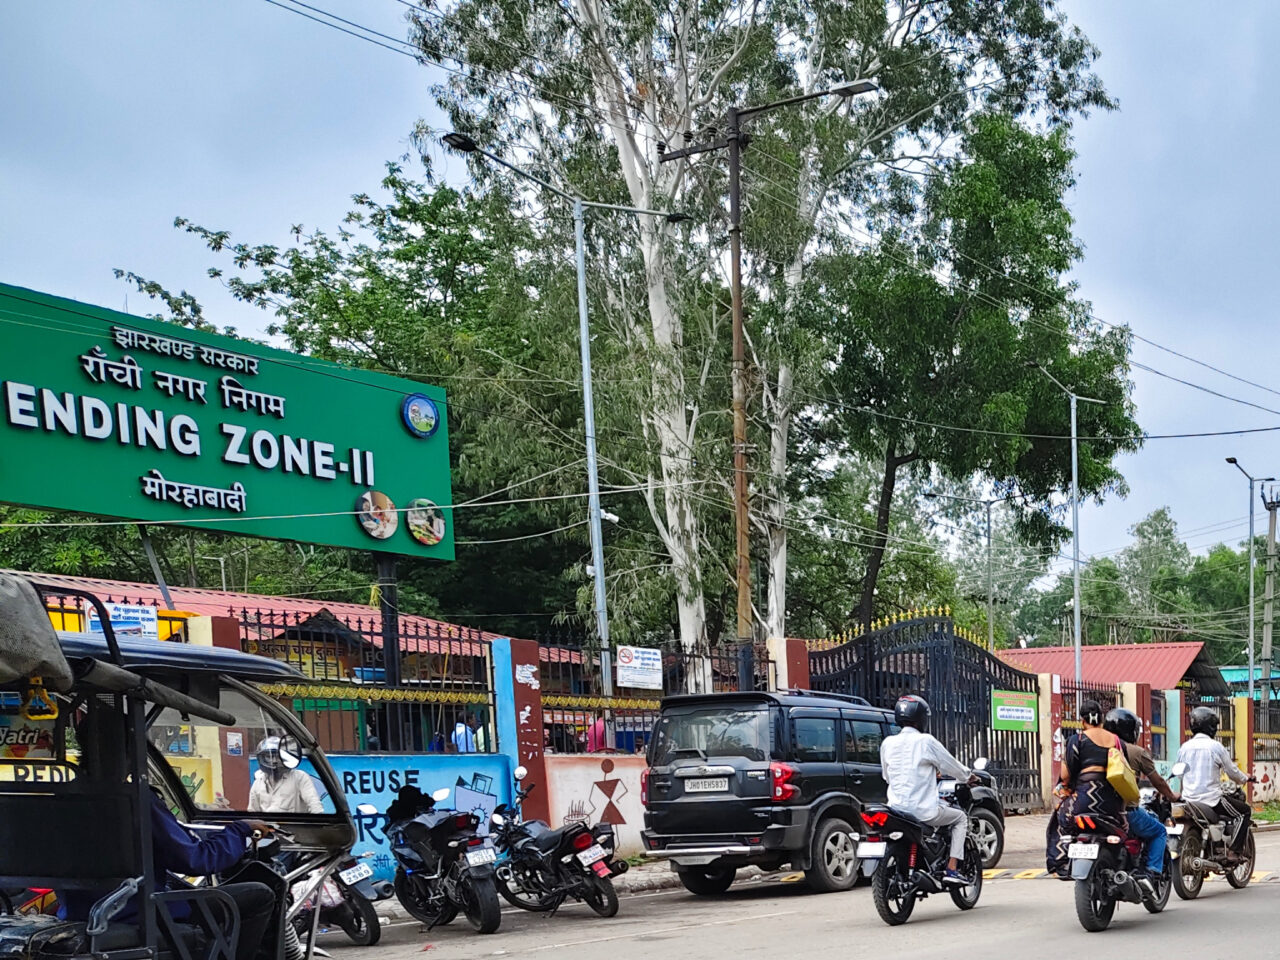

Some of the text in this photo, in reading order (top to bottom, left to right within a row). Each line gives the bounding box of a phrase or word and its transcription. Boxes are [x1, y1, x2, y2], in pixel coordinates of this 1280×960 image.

[112, 326, 260, 375] झारखण्ड सरकार
[80, 345, 286, 418] राँची नगर निगम
[220, 422, 376, 487] ZONE-II
[140, 470, 247, 513] मोरहाबादी
[343, 770, 421, 794] REUSE
[346, 868, 371, 883] 2589
